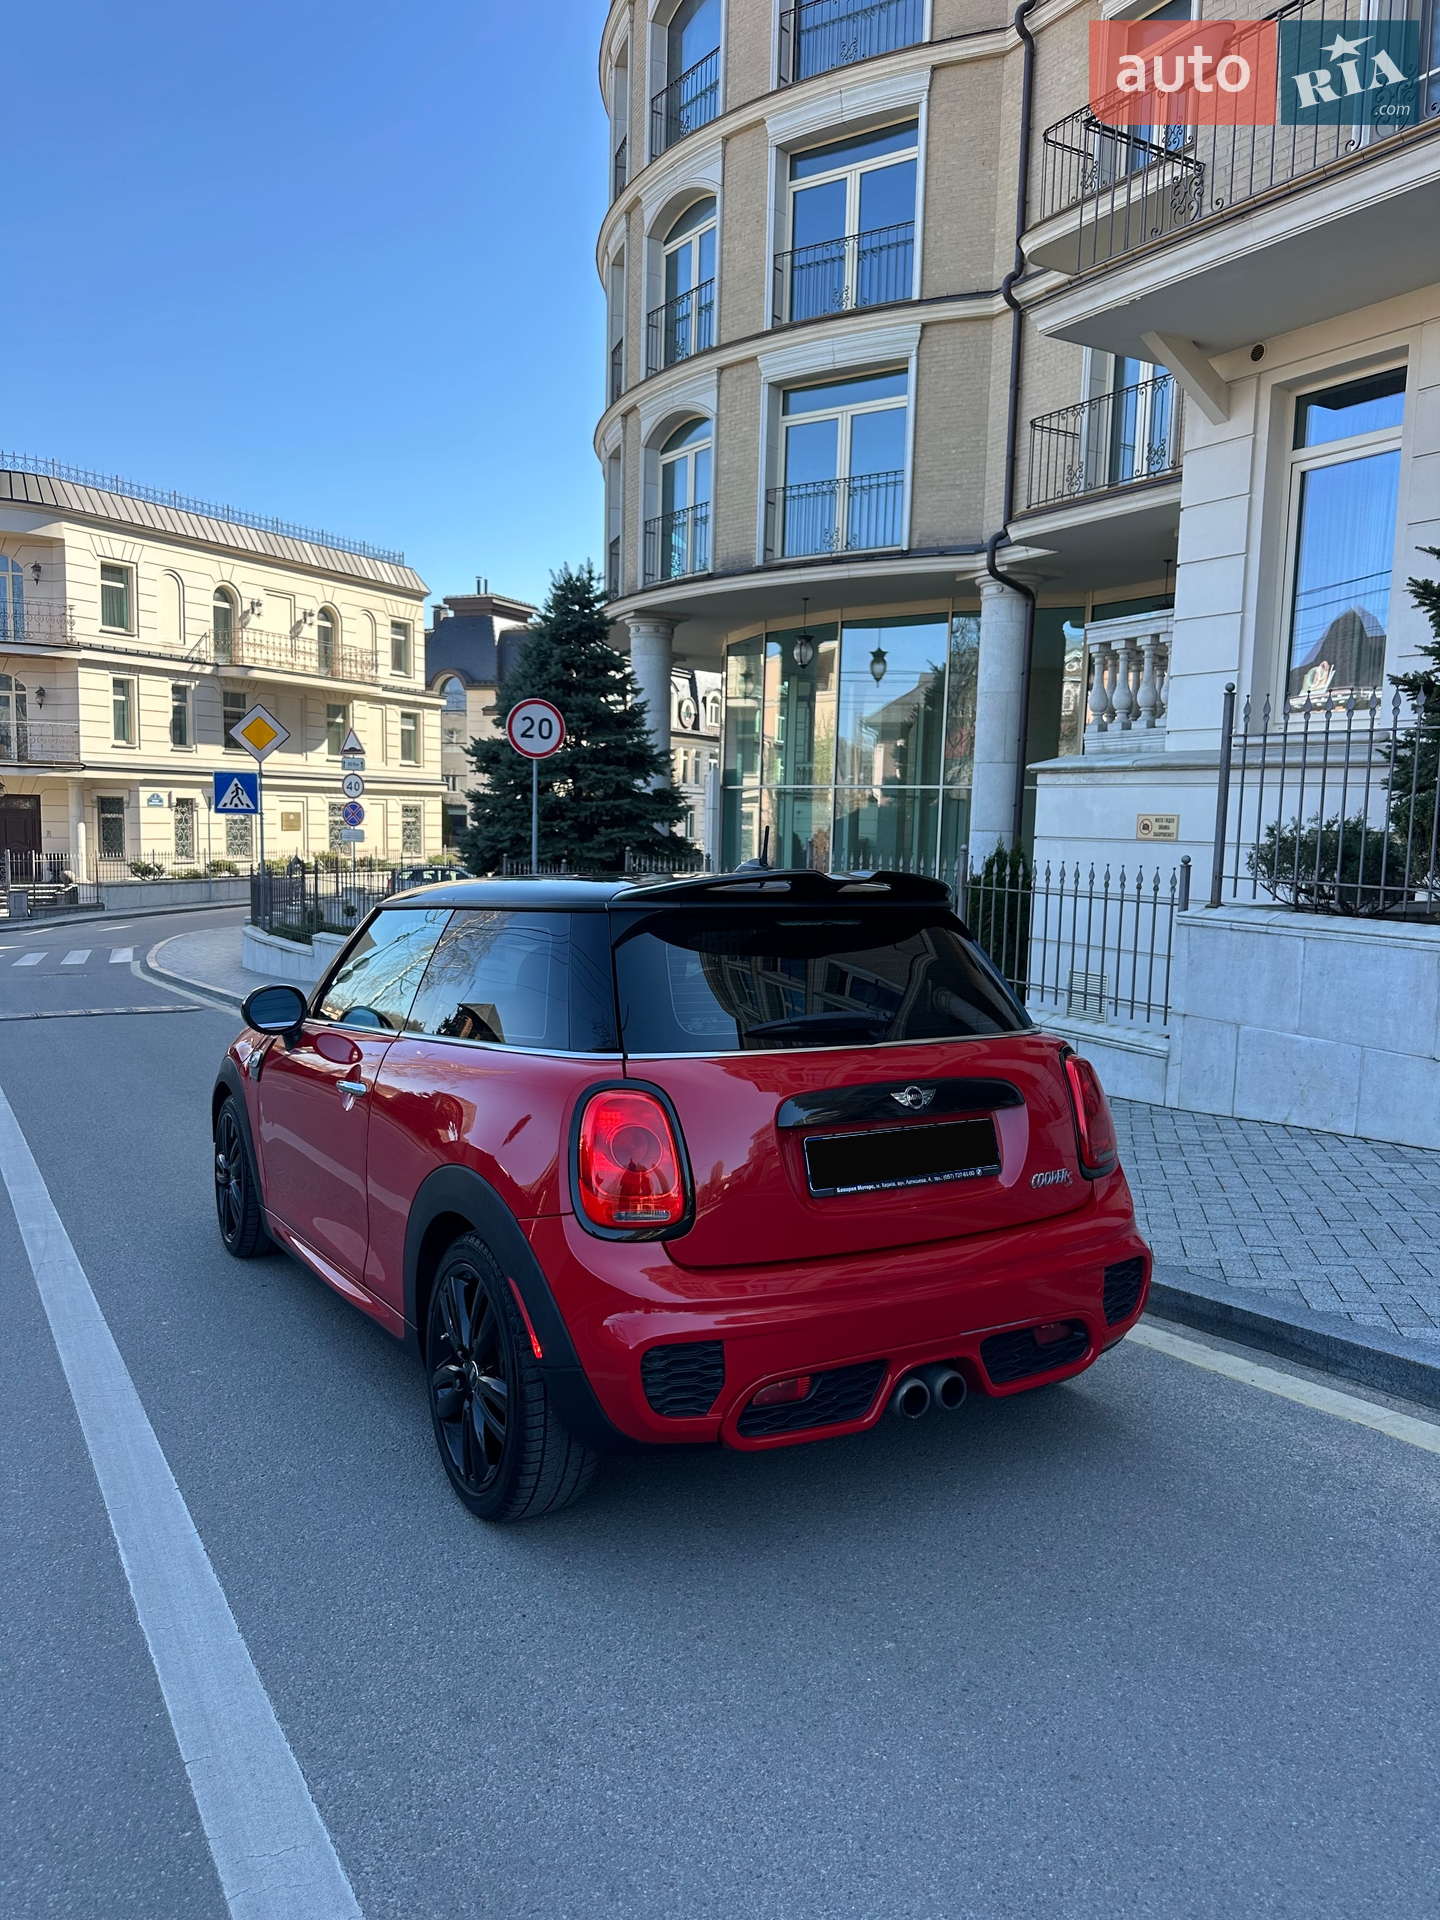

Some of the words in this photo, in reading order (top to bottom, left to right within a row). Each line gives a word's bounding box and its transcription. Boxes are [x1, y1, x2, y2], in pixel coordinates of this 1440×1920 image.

[520, 716, 553, 740] 20
[346, 781, 360, 791] 40
[1031, 1168, 1067, 1189] COOPER
